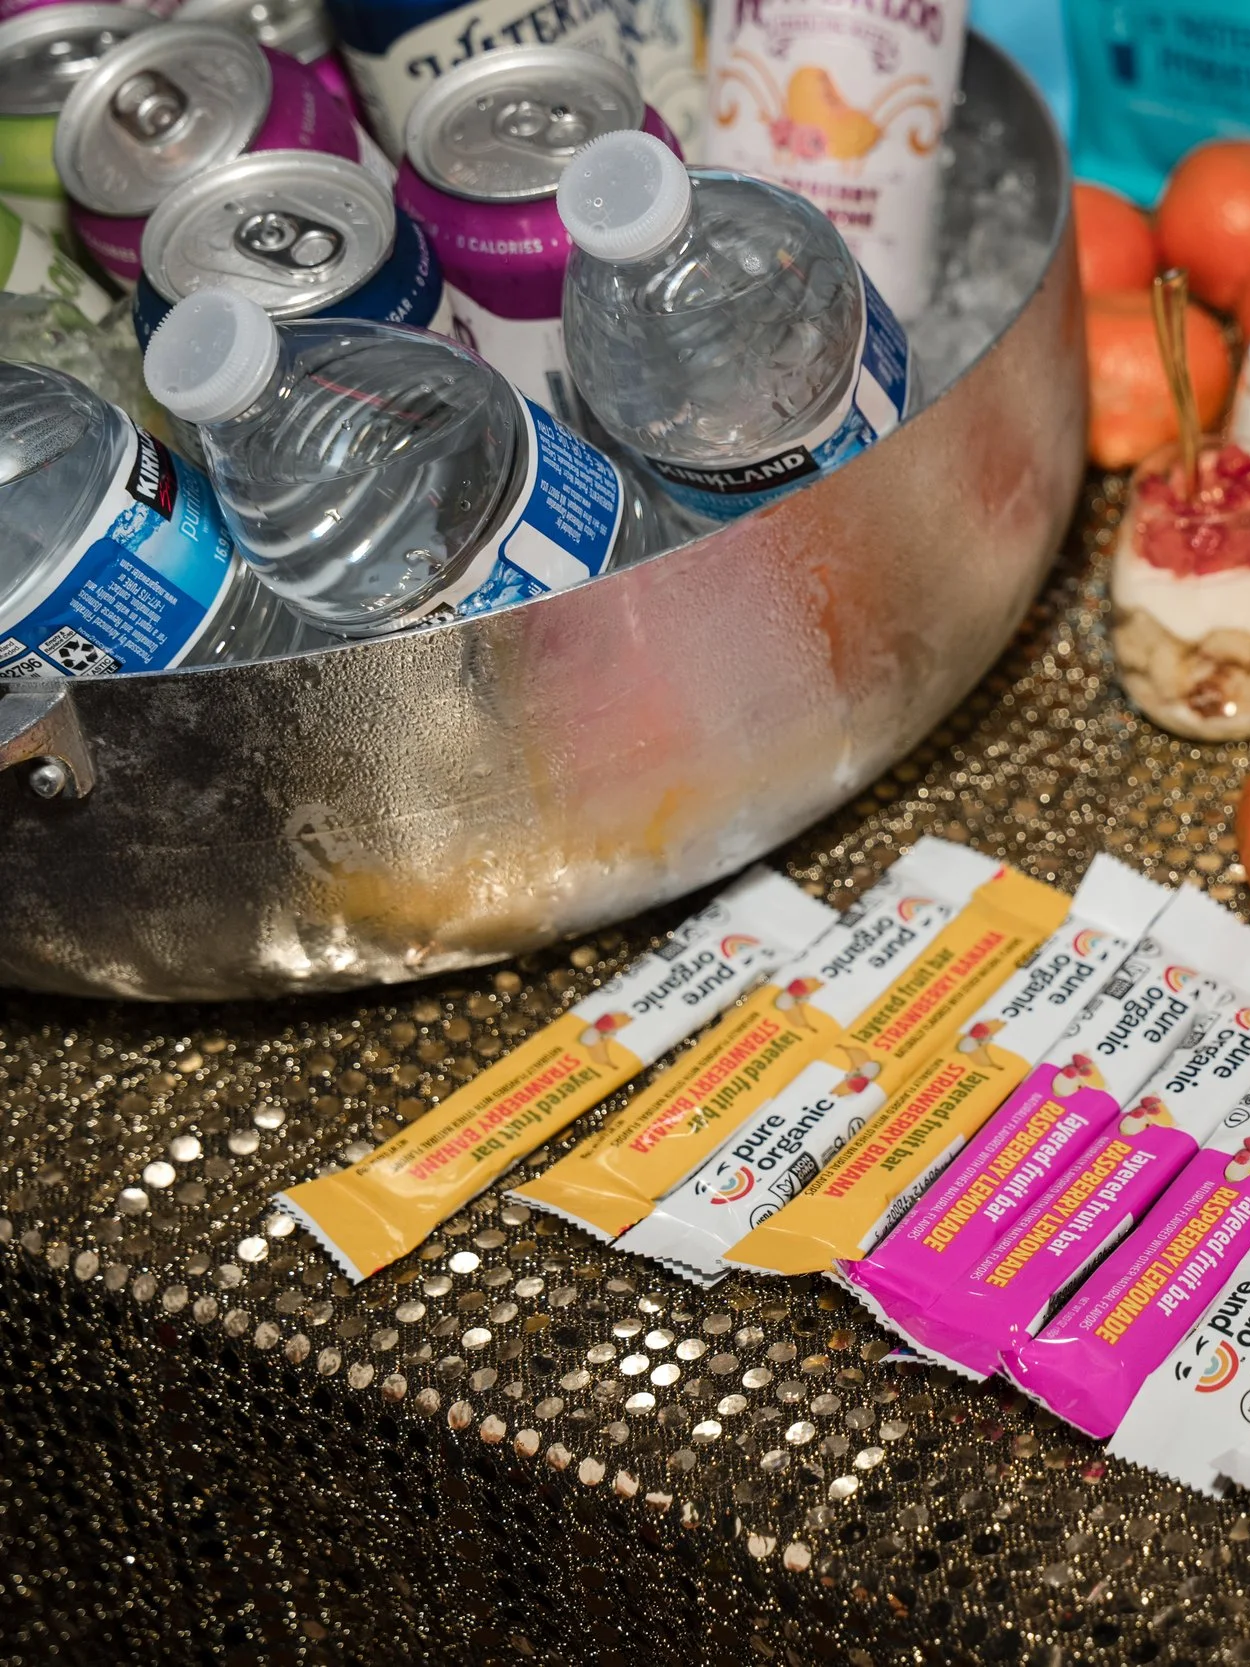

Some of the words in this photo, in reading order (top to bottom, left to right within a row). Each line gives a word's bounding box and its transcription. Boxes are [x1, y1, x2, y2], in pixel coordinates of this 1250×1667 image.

[467, 236, 543, 254] CALORIES
[657, 452, 805, 487] KIRKLAND
[212, 537, 232, 563] 16.9
[82, 578, 98, 593] and
[93, 584, 118, 606] quality
[121, 576, 142, 595] PURE
[91, 615, 121, 640] Advanced
[97, 605, 123, 627] Reverse
[111, 599, 131, 617] water
[118, 620, 134, 635] and
[153, 631, 168, 645] For
[822, 917, 895, 978] organic
[869, 926, 916, 968] pure
[633, 952, 715, 1013] organic
[682, 962, 735, 1005] pure
[1002, 954, 1078, 1018] organic
[1048, 962, 1094, 1004] pure
[874, 975, 954, 1050] STRAWBERRY
[1097, 987, 1172, 1055] organic
[1143, 996, 1188, 1043] pure
[689, 1020, 779, 1100] STRAWBERRY
[746, 1031, 802, 1082] layered
[1166, 1029, 1240, 1093] organic
[479, 1055, 580, 1131] STRAWBERRY
[536, 1067, 601, 1115] layered
[710, 1076, 752, 1110] fruit
[880, 1064, 965, 1145] STRAWBERRY
[933, 1071, 989, 1120] layered
[411, 1127, 482, 1179] BANANA
[471, 1137, 504, 1162] bar
[732, 1115, 785, 1163] pure
[750, 1100, 834, 1170] organic
[901, 1114, 942, 1155] fruit
[990, 1101, 1064, 1178] RASPBERRY
[1033, 1113, 1088, 1168] layered
[824, 1144, 886, 1197] BANANA
[880, 1147, 908, 1172] bar
[1004, 1162, 1044, 1198] fruit
[1054, 1140, 1131, 1216] RASPBERRY
[1098, 1150, 1156, 1202] layered
[924, 1174, 998, 1251] LEMONADE
[984, 1194, 1016, 1222] bar
[1068, 1200, 1110, 1232] fruit
[1181, 1177, 1215, 1214] NATURALLY
[1047, 1225, 1081, 1256] bar
[1155, 1207, 1189, 1243] FLAVORED
[1162, 1187, 1238, 1266] RASPBERRY
[987, 1214, 1062, 1287] LEMONADE
[1124, 1252, 1150, 1279] OTHER
[1141, 1236, 1163, 1259] WITH
[1101, 1271, 1133, 1305] NATURAL
[1178, 1250, 1217, 1290] fruit
[1076, 1298, 1109, 1333] FLAVORS
[1096, 1262, 1172, 1343] LEMONADE
[1157, 1284, 1189, 1316] bar
